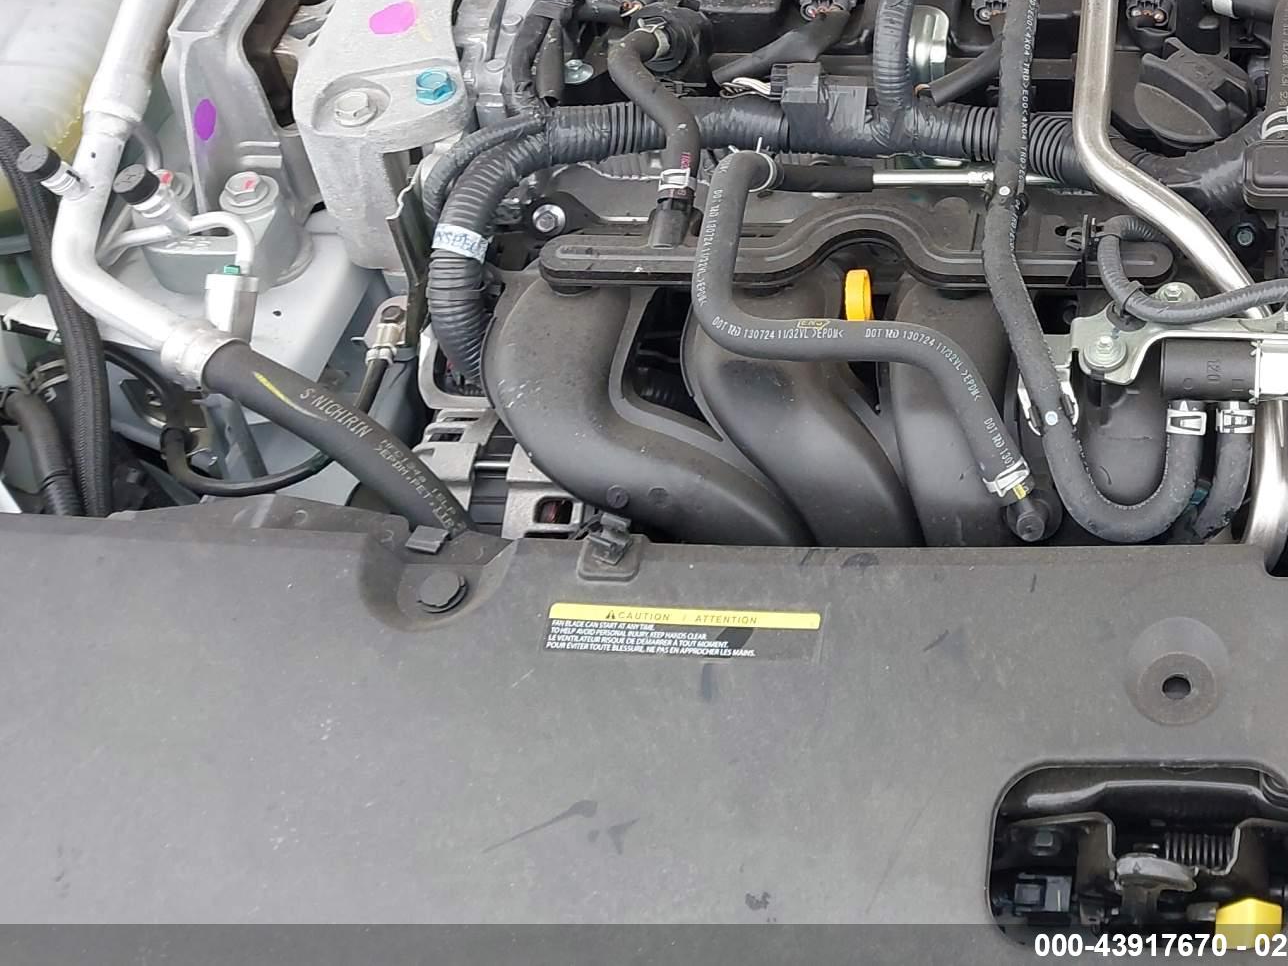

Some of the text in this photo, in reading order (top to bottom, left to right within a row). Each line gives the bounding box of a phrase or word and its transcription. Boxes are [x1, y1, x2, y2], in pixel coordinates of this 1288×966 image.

[743, 329, 775, 340] 130724
[864, 328, 883, 338] DOT
[902, 330, 936, 347] 130724
[618, 611, 670, 621] CAUTION
[695, 615, 757, 624] ATTENTION
[557, 635, 601, 643] VENTILATEUR
[595, 629, 627, 637] PERSONAL
[649, 631, 664, 639] KEEP
[546, 641, 565, 649] POUR
[589, 643, 611, 651] TOUTE
[679, 647, 719, 655] APPROCHER
